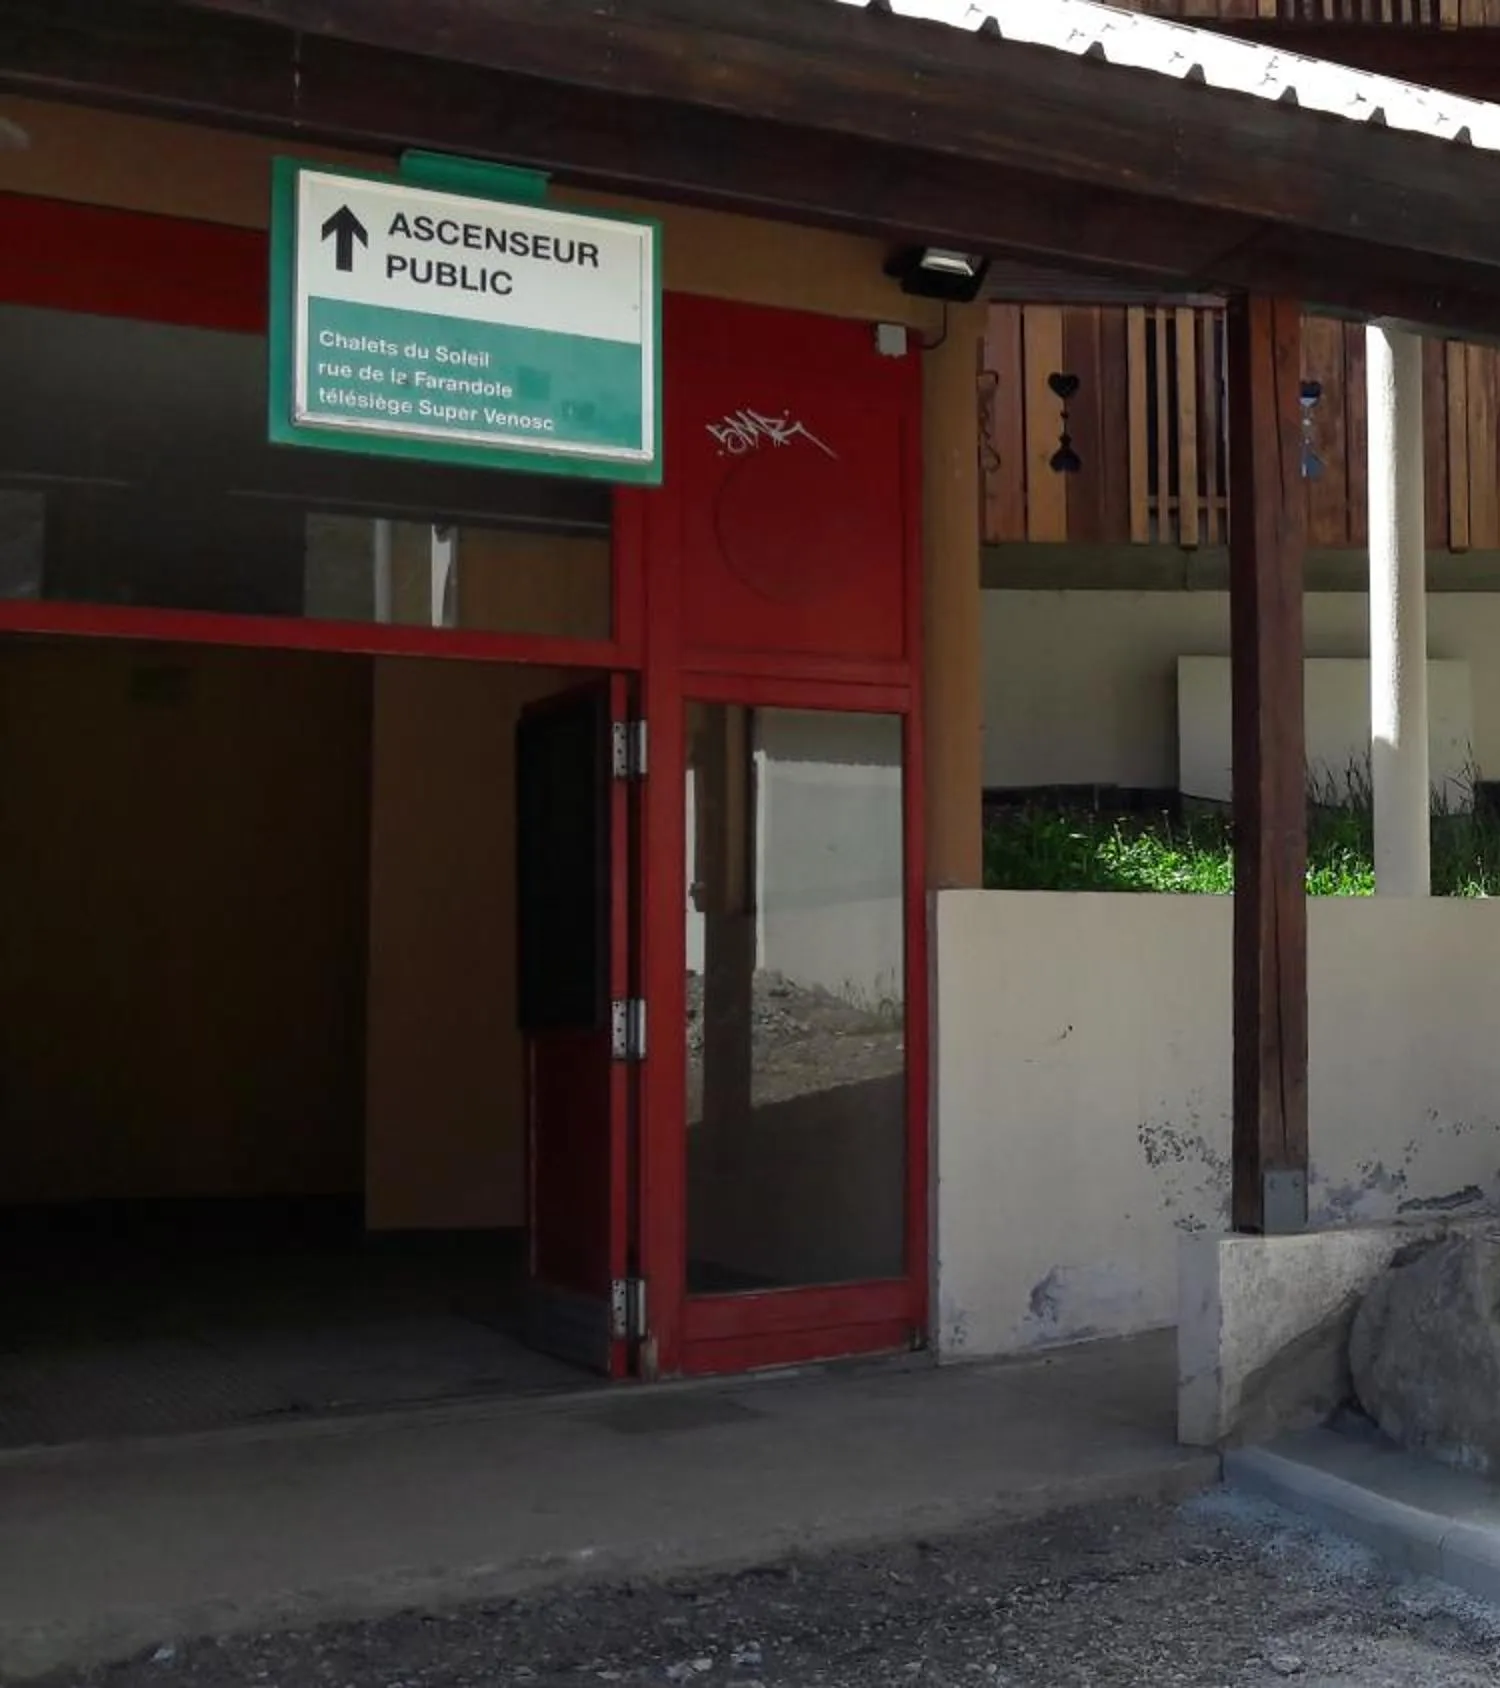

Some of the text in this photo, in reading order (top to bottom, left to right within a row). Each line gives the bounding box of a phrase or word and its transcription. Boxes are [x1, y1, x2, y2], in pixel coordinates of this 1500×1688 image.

[388, 212, 600, 269] ASCENSEUR
[386, 255, 514, 296] PUBLIC
[318, 329, 490, 369] Chalets du Soleil
[318, 362, 513, 400] rue de la Farandole
[318, 387, 555, 432] télésiège Super Venosc
